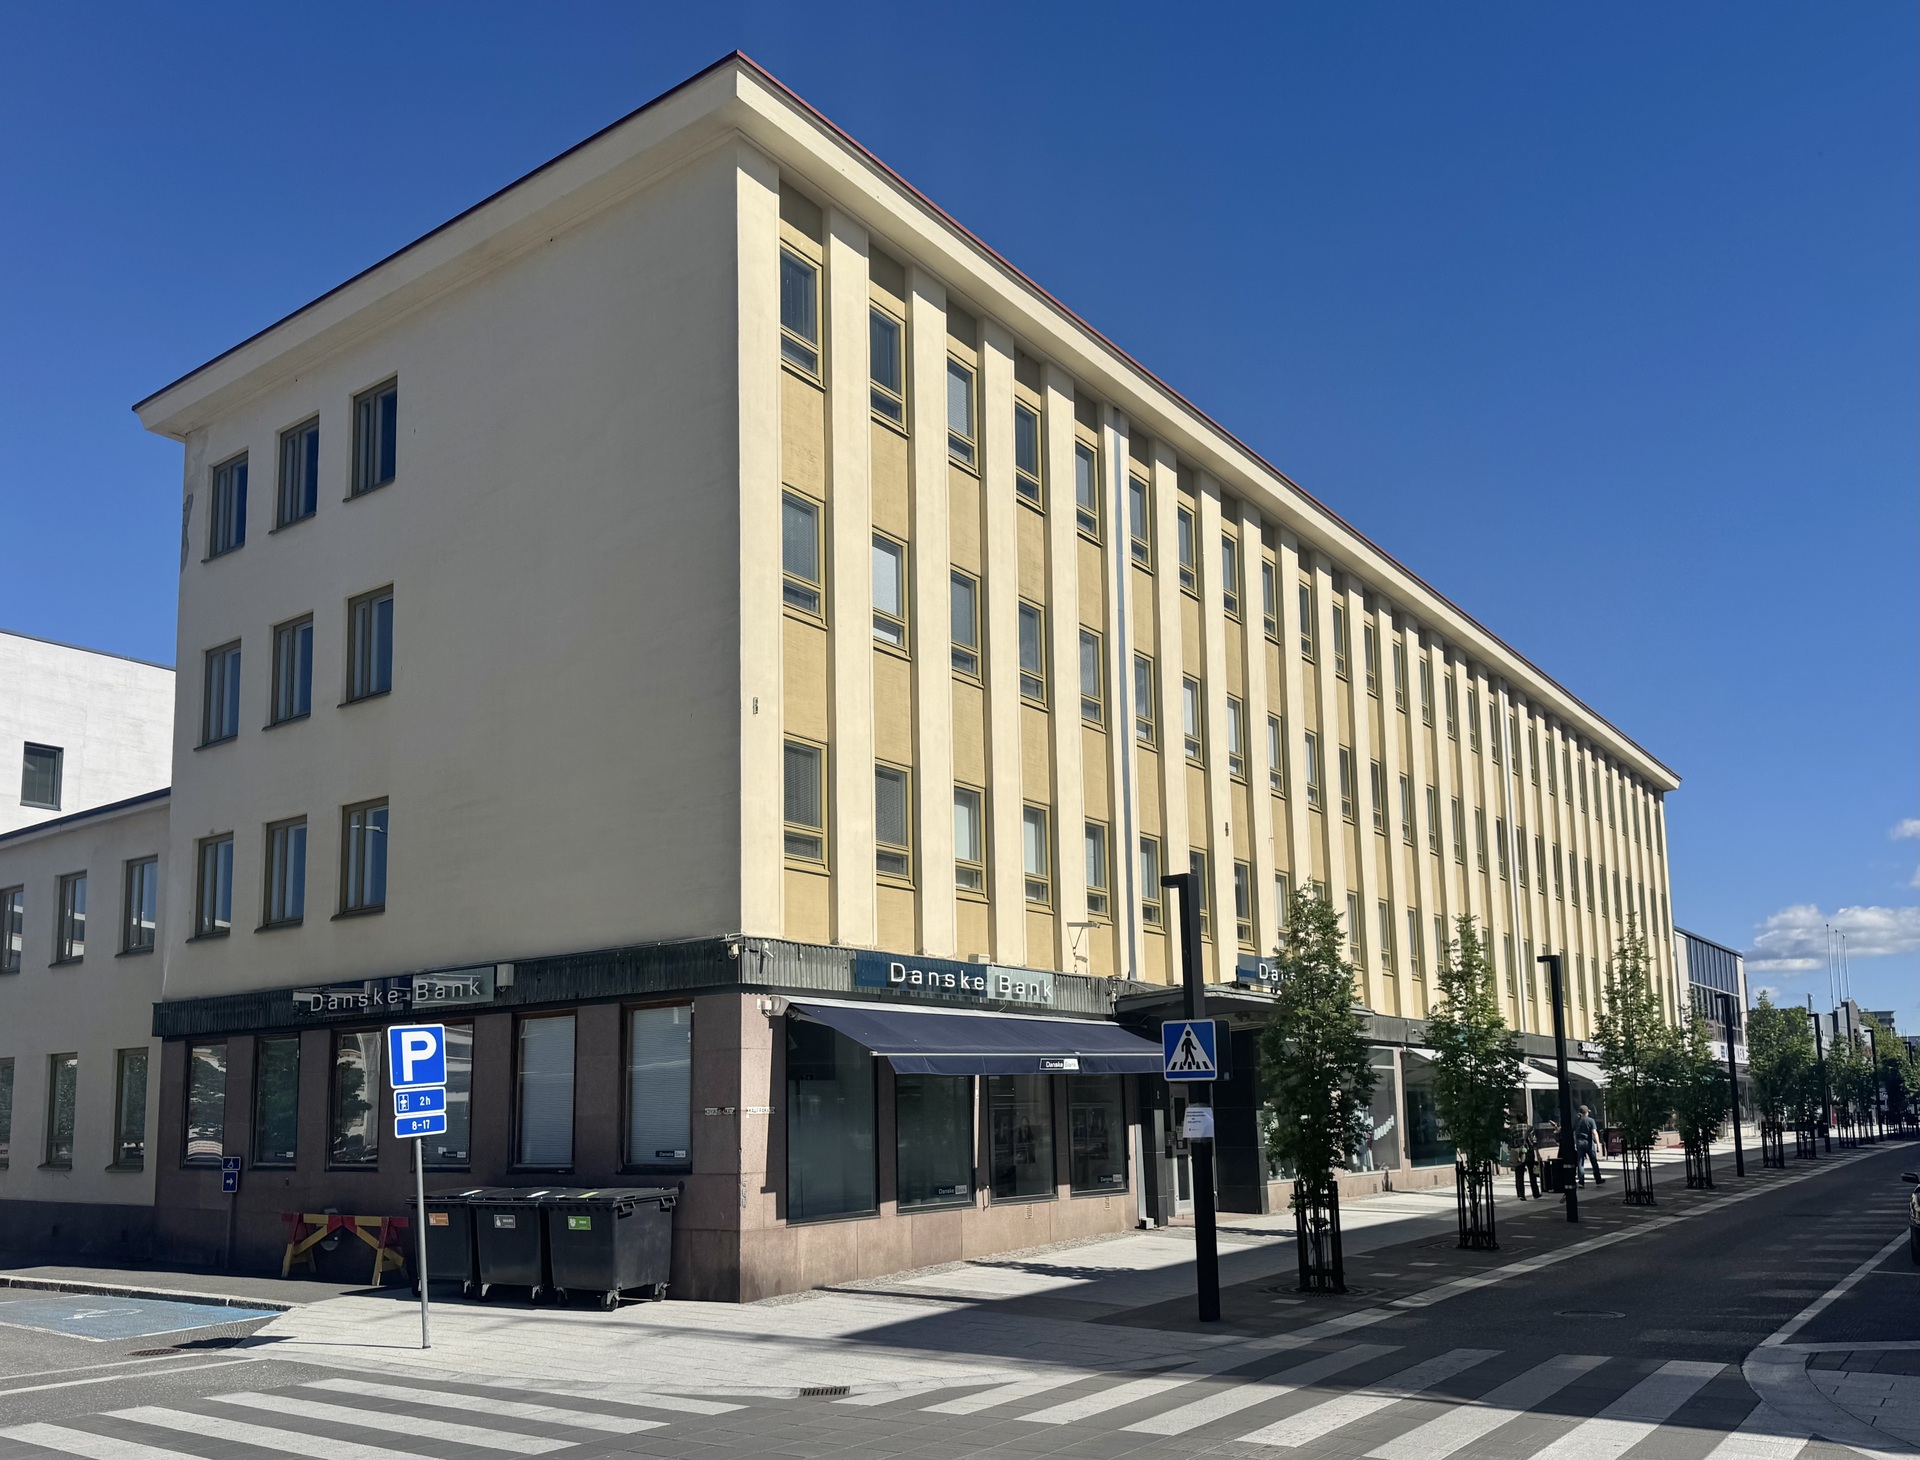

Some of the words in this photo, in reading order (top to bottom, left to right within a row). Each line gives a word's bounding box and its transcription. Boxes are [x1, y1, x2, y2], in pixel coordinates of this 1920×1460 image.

[310, 987, 399, 1012] Danske
[415, 977, 481, 1002] Bank
[890, 962, 986, 991] Danske
[999, 975, 1053, 998] Bank
[401, 1031, 437, 1082] P
[419, 1096, 431, 1106] 2h
[411, 1119, 431, 1131] 8-17
